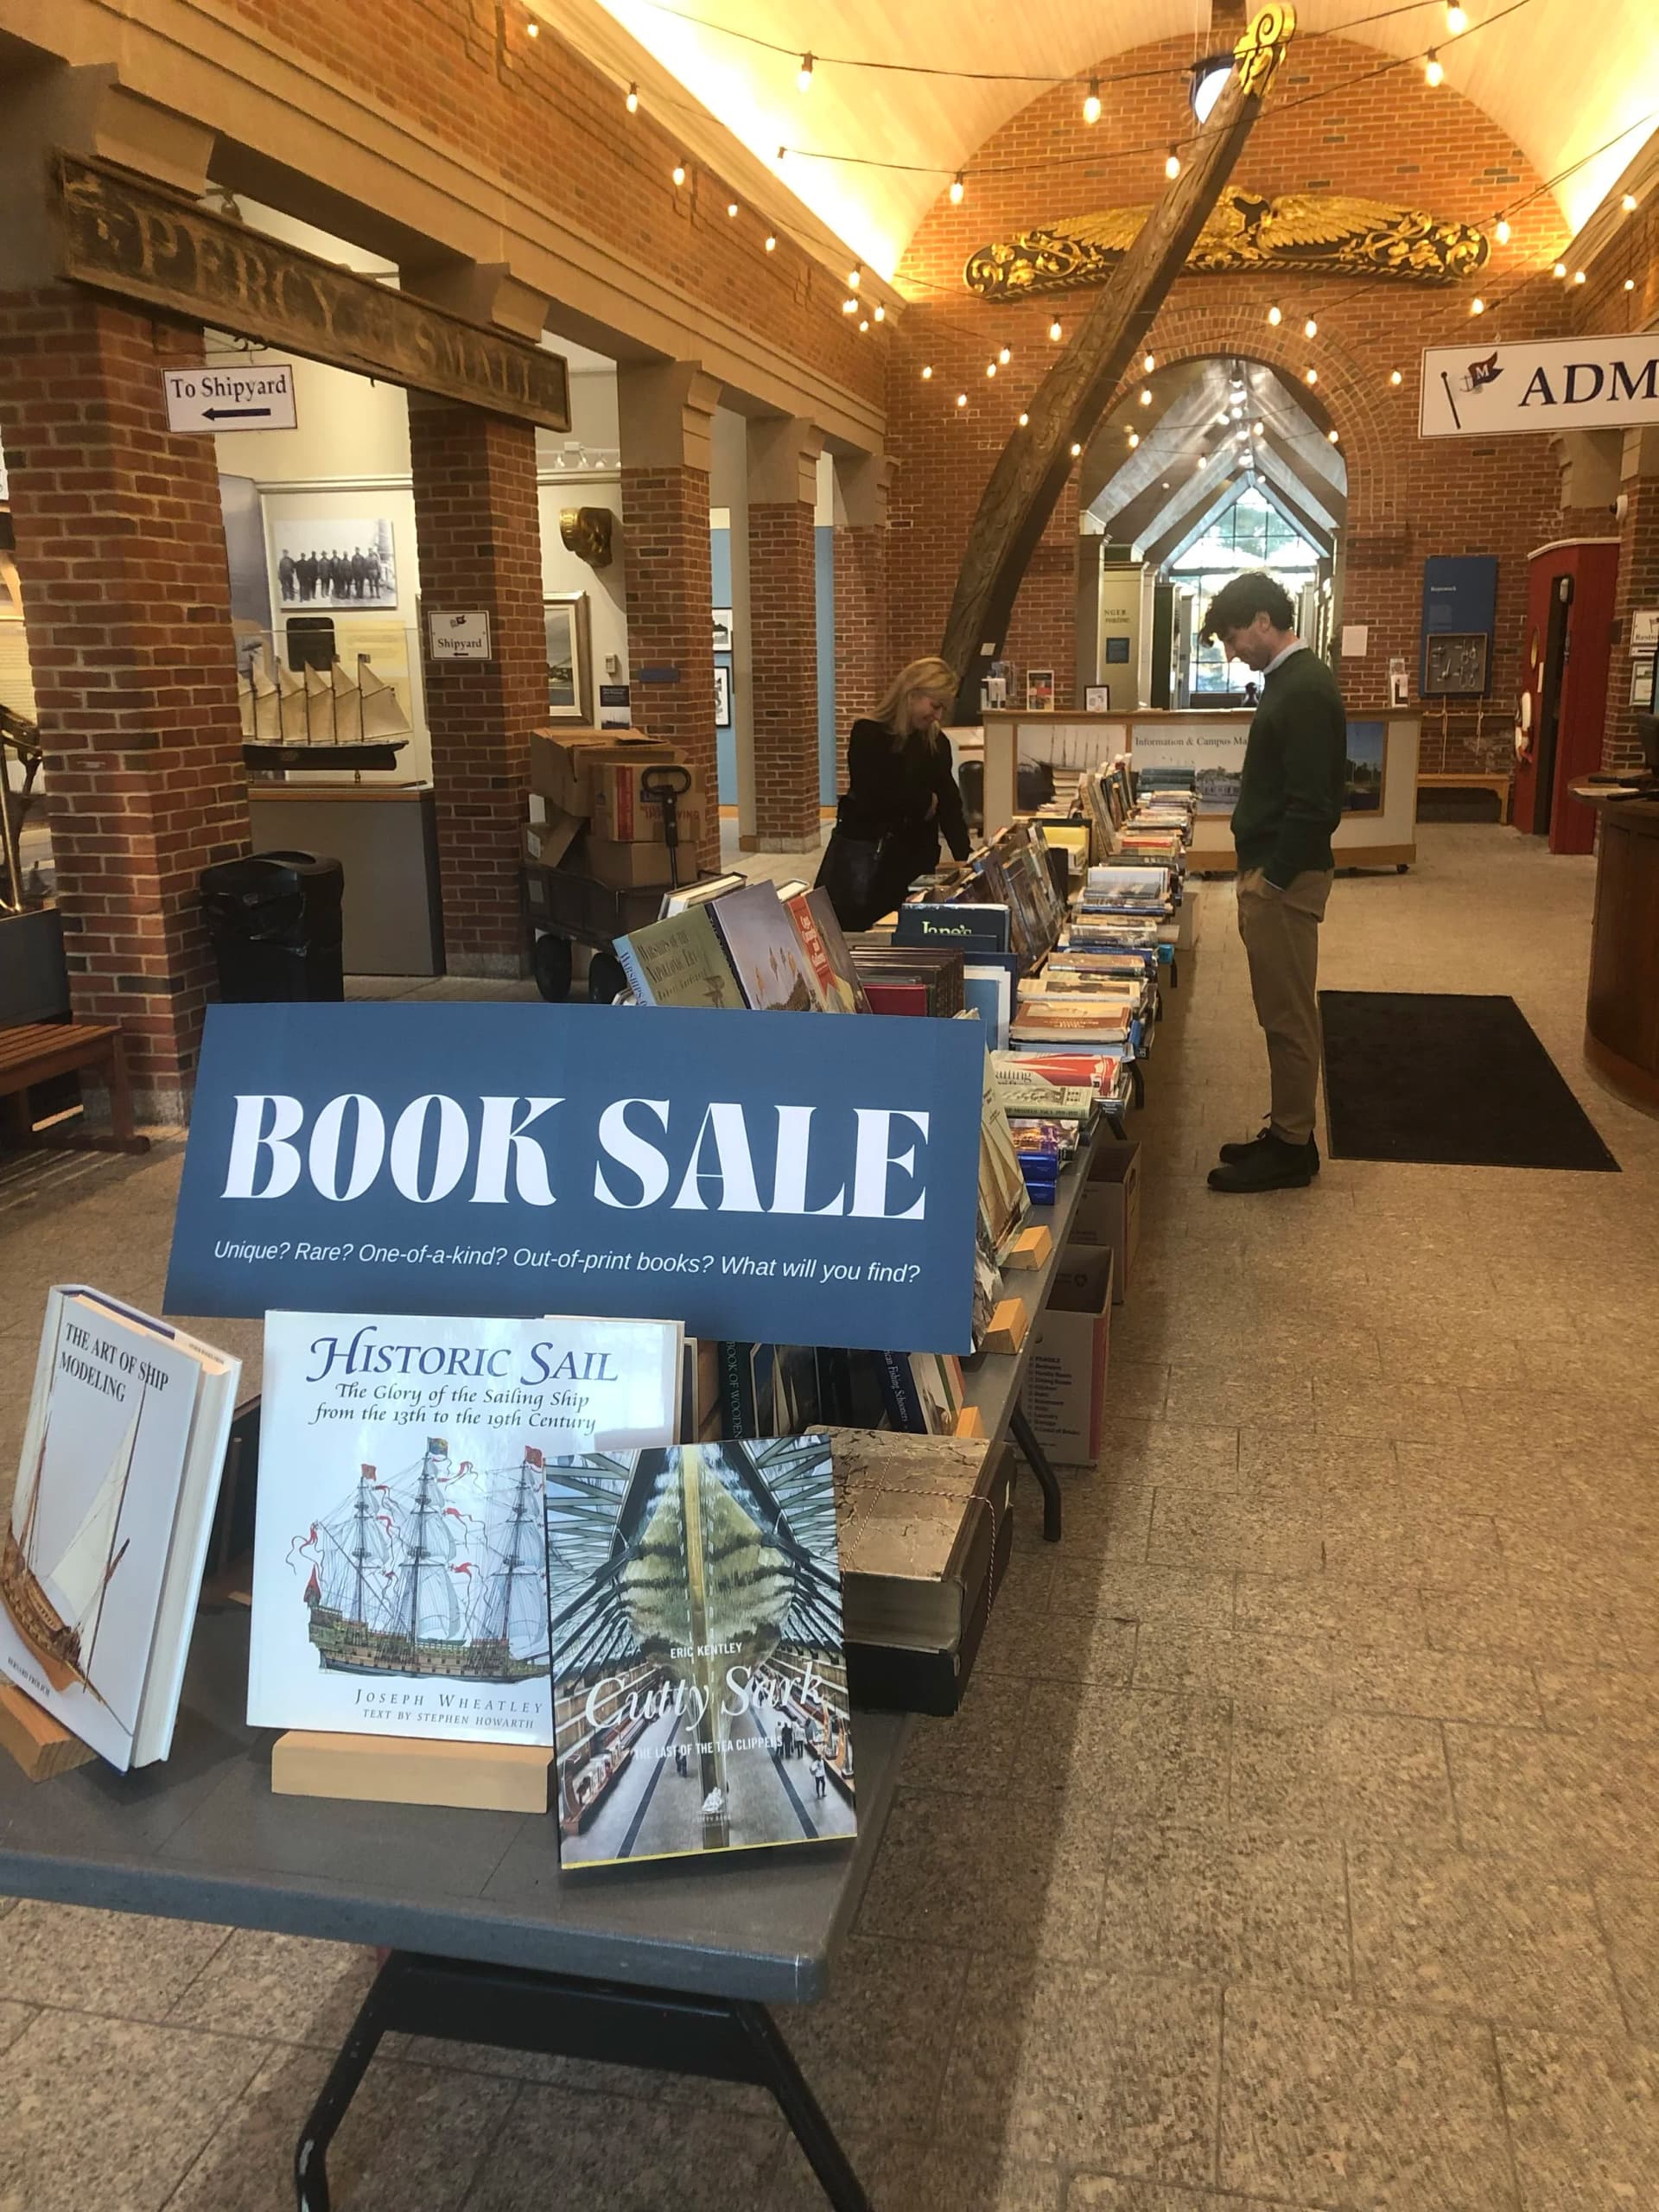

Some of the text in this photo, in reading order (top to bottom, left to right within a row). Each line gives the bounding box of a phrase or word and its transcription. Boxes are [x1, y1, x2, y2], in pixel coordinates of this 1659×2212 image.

[170, 373, 287, 403] To Shipyard
[1517, 358, 1659, 407] ADM
[437, 638, 482, 651] Shipyard
[1135, 736, 1184, 747] Information
[1185, 736, 1193, 747] &
[1197, 736, 1231, 748] Campus
[219, 1093, 931, 1220] BOOK SALE
[213, 1240, 921, 1284] Unique? Rare? One-of-a-kind? Out-of-print books? What will you find?
[66, 1322, 169, 1392] THE ART OF SHIP
[306, 1325, 619, 1386] HISTORIC SAIL
[60, 1351, 127, 1403] MODELING
[726, 1341, 743, 1439] BOOK OF WOODEN
[887, 1365, 900, 1390] Fishing
[894, 1389, 909, 1422] Schooners
[335, 1382, 589, 1414] The Glory of the Sailing Ship
[308, 1402, 596, 1436] from the 13th to the 19th Century
[670, 1642, 743, 1660] ERIC KENTLEY
[355, 1688, 543, 1713] JOSEPH WHEATLEY
[585, 1661, 823, 1732] Cutty Sark
[363, 1708, 534, 1729] TEXT BY STEPHEN HOWARTH
[632, 1735, 784, 1760] THE LAST OF THE TEA CLIPPERS
